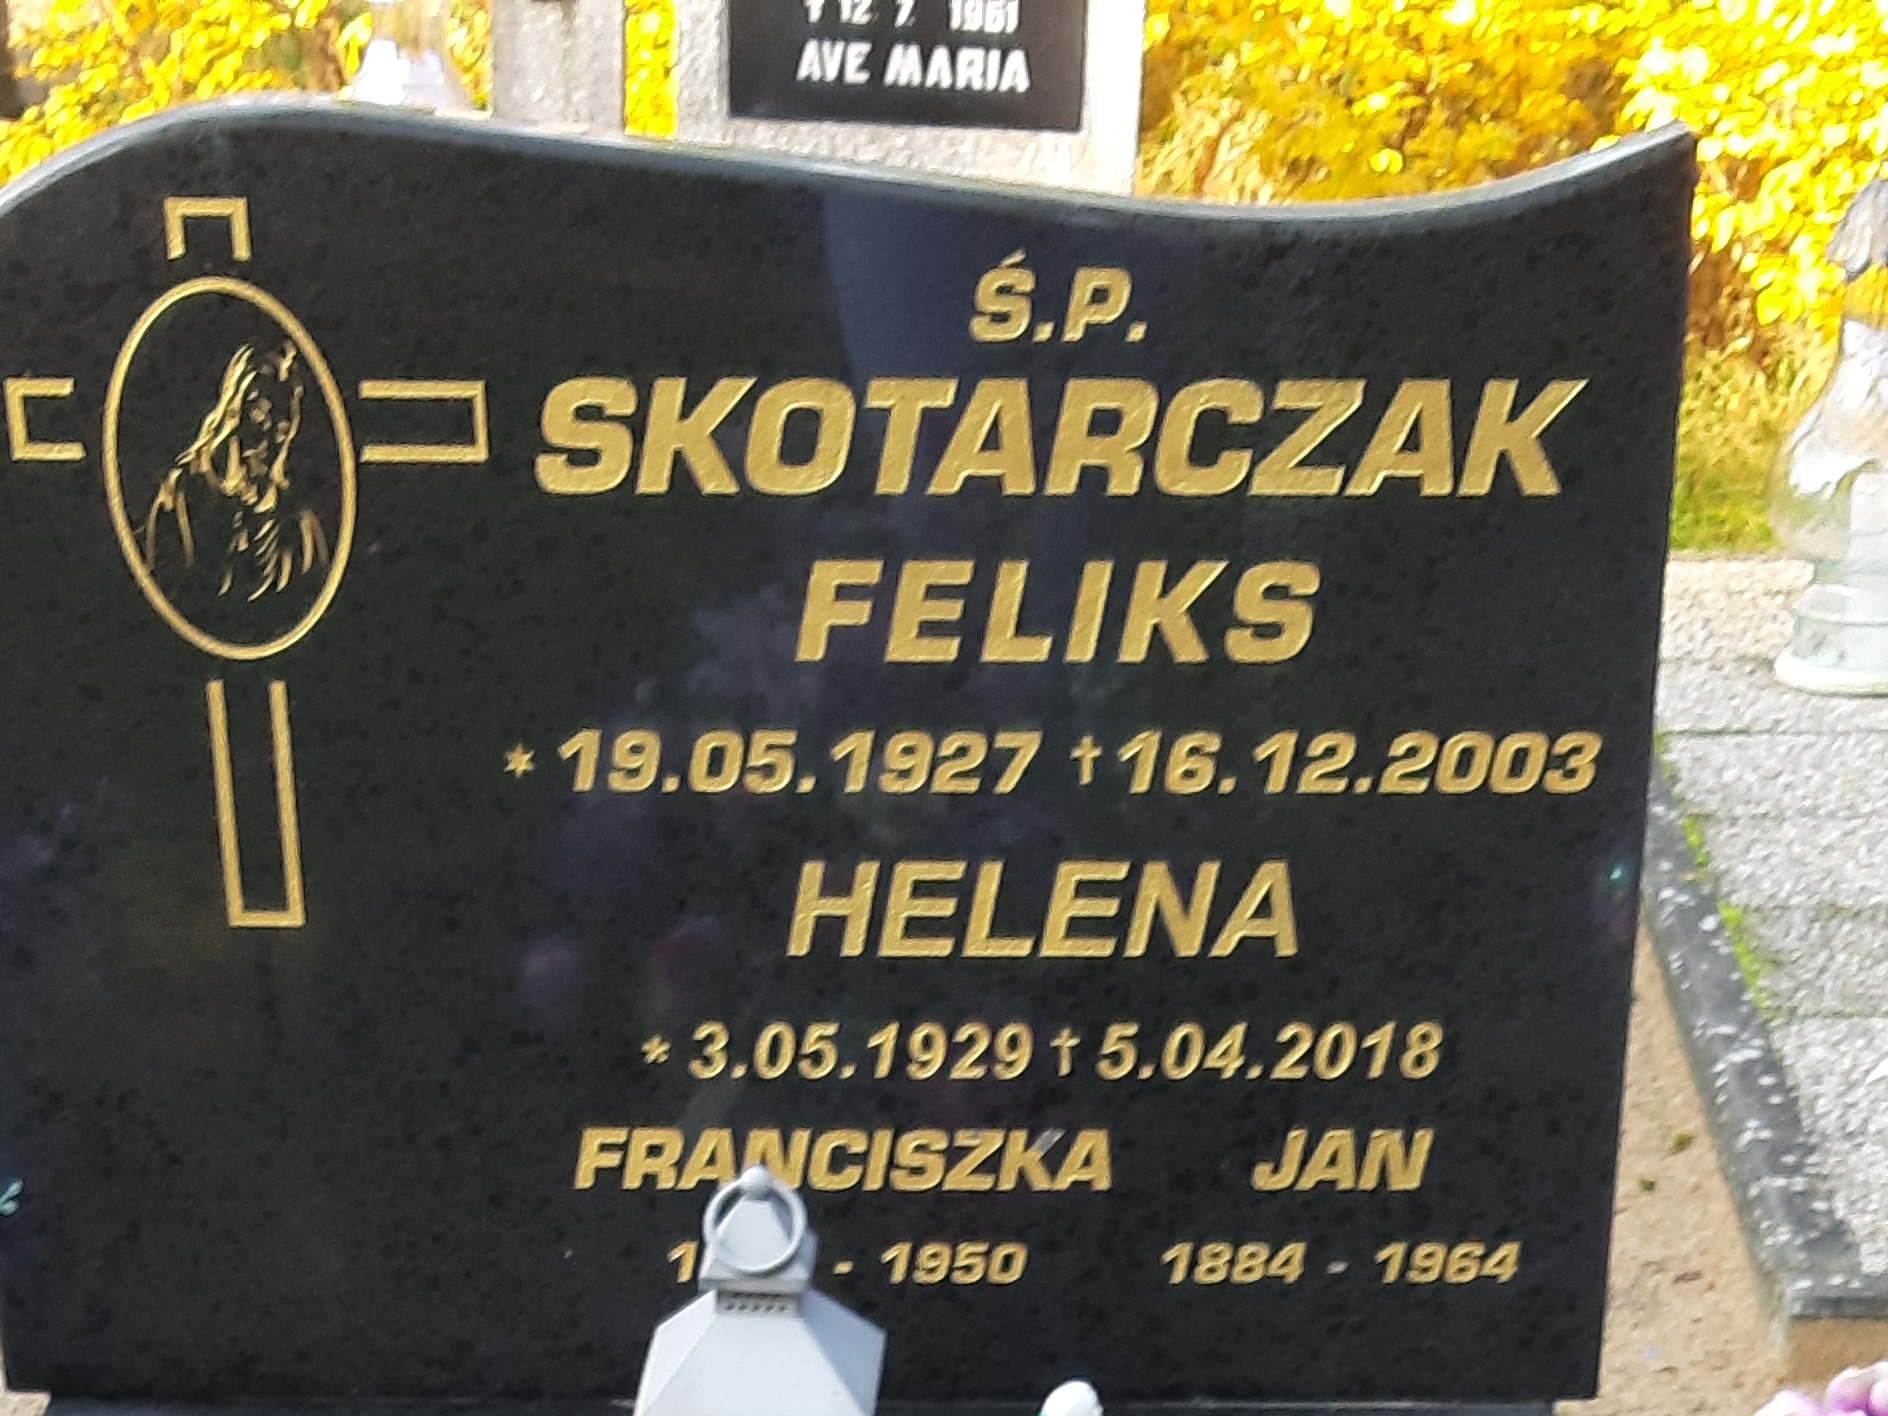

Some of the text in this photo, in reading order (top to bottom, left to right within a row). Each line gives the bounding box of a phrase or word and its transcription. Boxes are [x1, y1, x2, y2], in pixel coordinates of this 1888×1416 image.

[796, 40, 1031, 94] AVE MARIA
[970, 250, 1148, 344] Ś.P.
[534, 375, 1587, 499] SKOTARCZAK
[795, 558, 1321, 665] FELIKS
[787, 859, 1299, 959] HELENA
[573, 1125, 1436, 1193] FRANCISZKA JAN
[880, 1240, 1029, 1286] 1950
[1161, 1240, 1307, 1286] 1884
[1375, 1240, 1522, 1286] 1964
